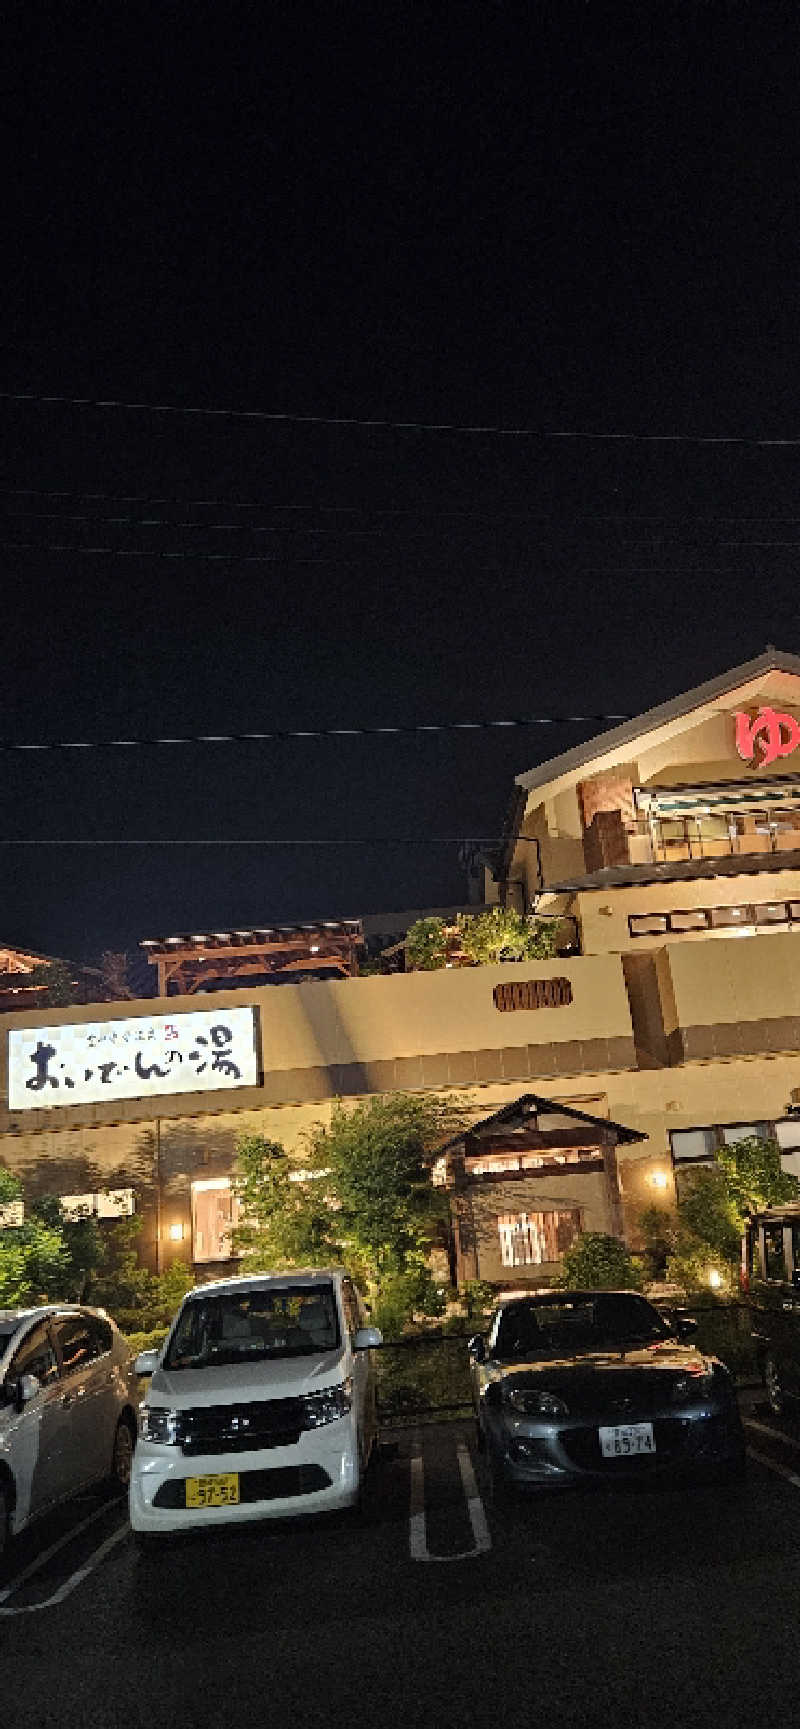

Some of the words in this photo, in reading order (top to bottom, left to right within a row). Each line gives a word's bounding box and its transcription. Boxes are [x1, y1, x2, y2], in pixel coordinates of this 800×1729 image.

[736, 707, 800, 768] ゆ
[25, 1024, 243, 1091] おいでんの湯
